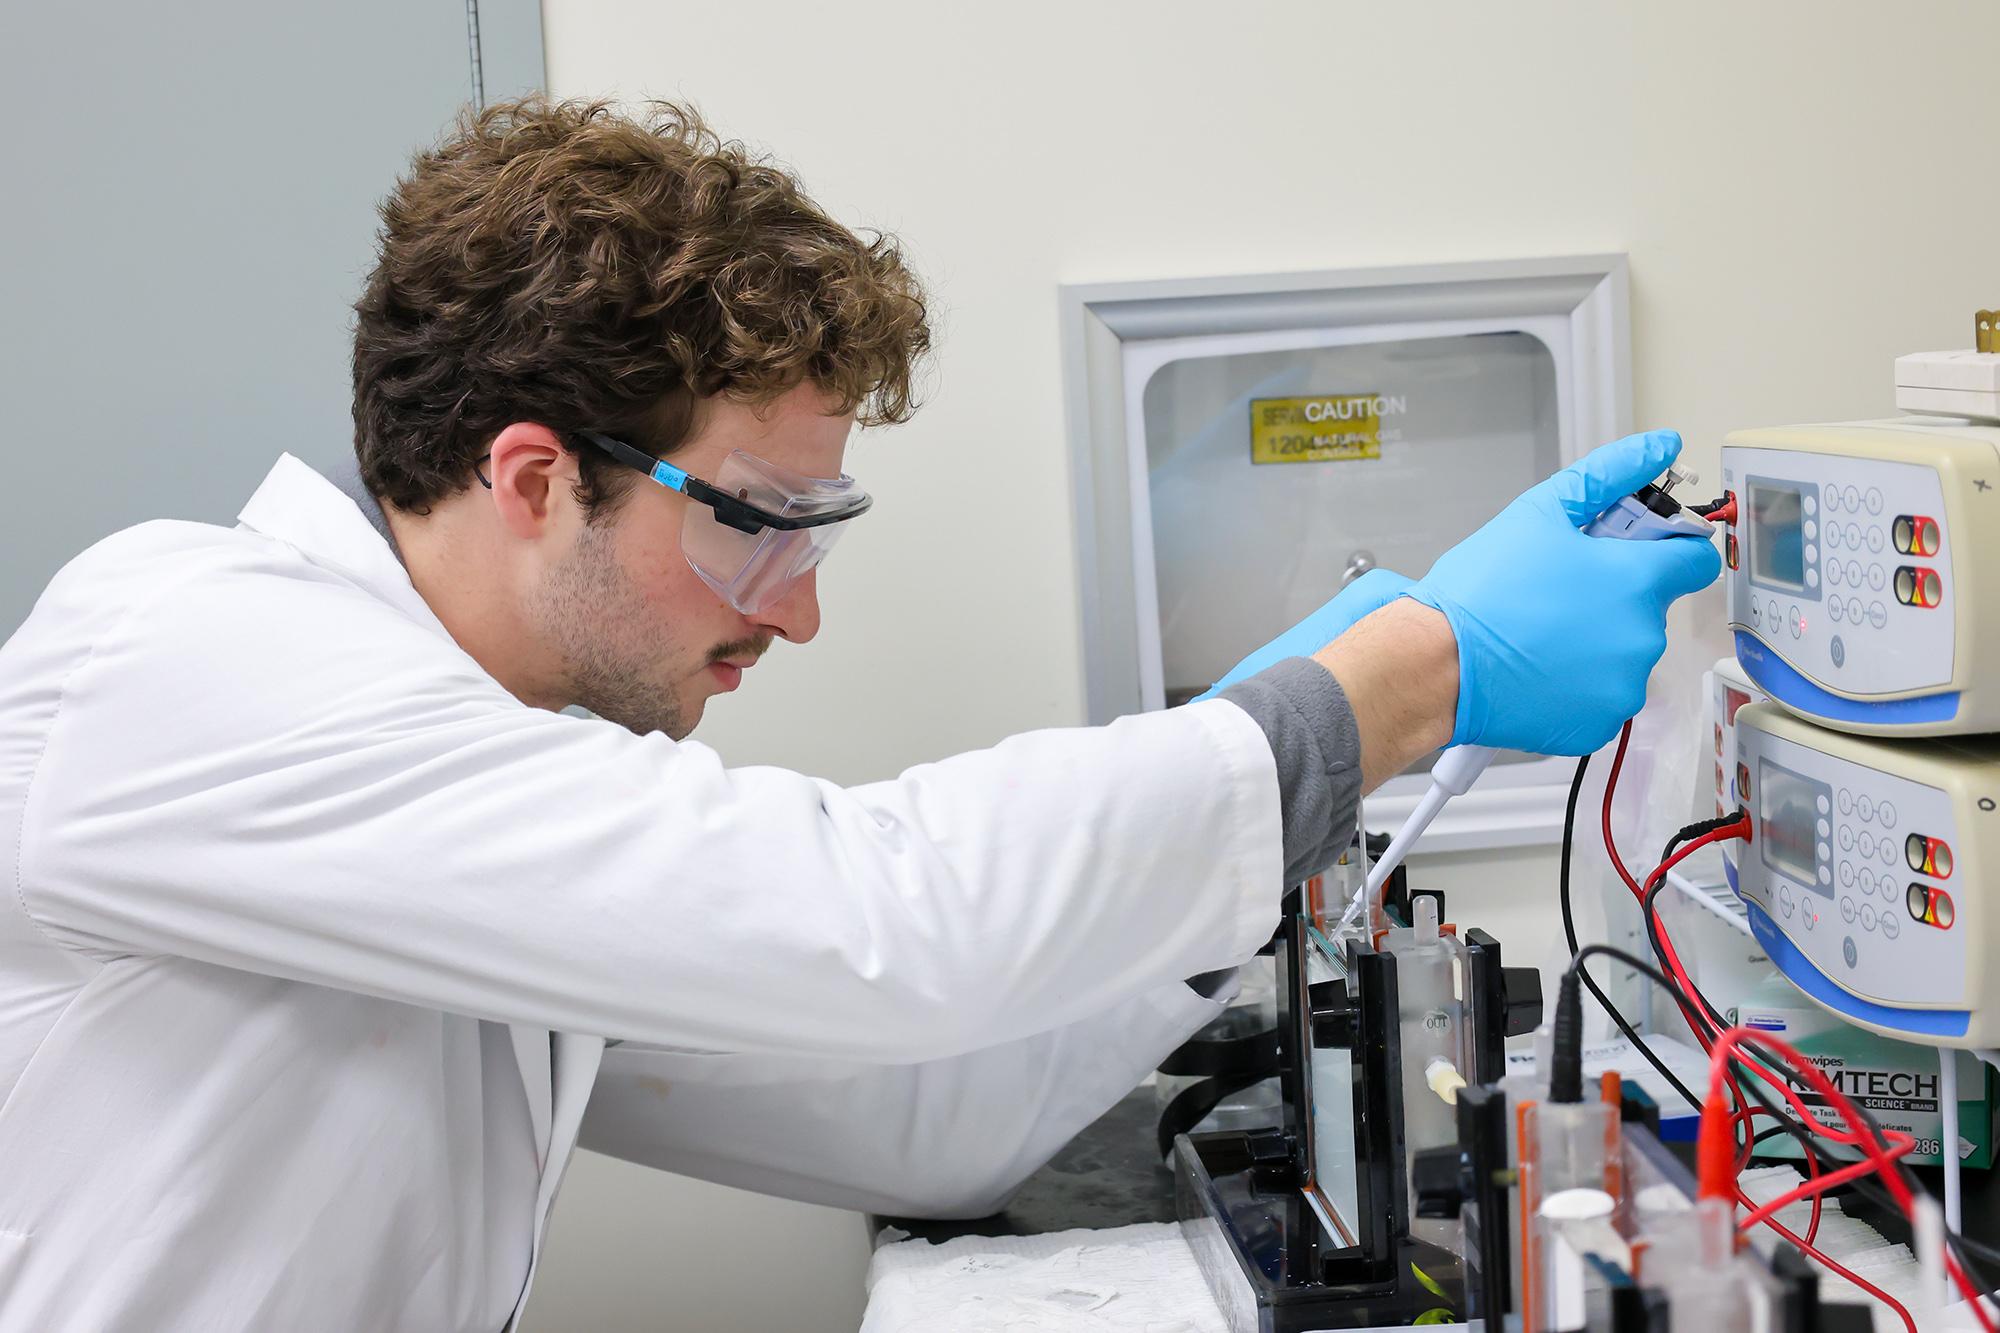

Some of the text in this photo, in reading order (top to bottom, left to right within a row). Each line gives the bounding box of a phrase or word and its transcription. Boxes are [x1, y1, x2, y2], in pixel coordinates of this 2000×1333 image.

[1304, 395, 1407, 422] CAUTION
[1786, 1055, 1844, 1068] mwipes
[1785, 1070, 1938, 1098] MTECH
[1913, 1138, 1940, 1155] 286
